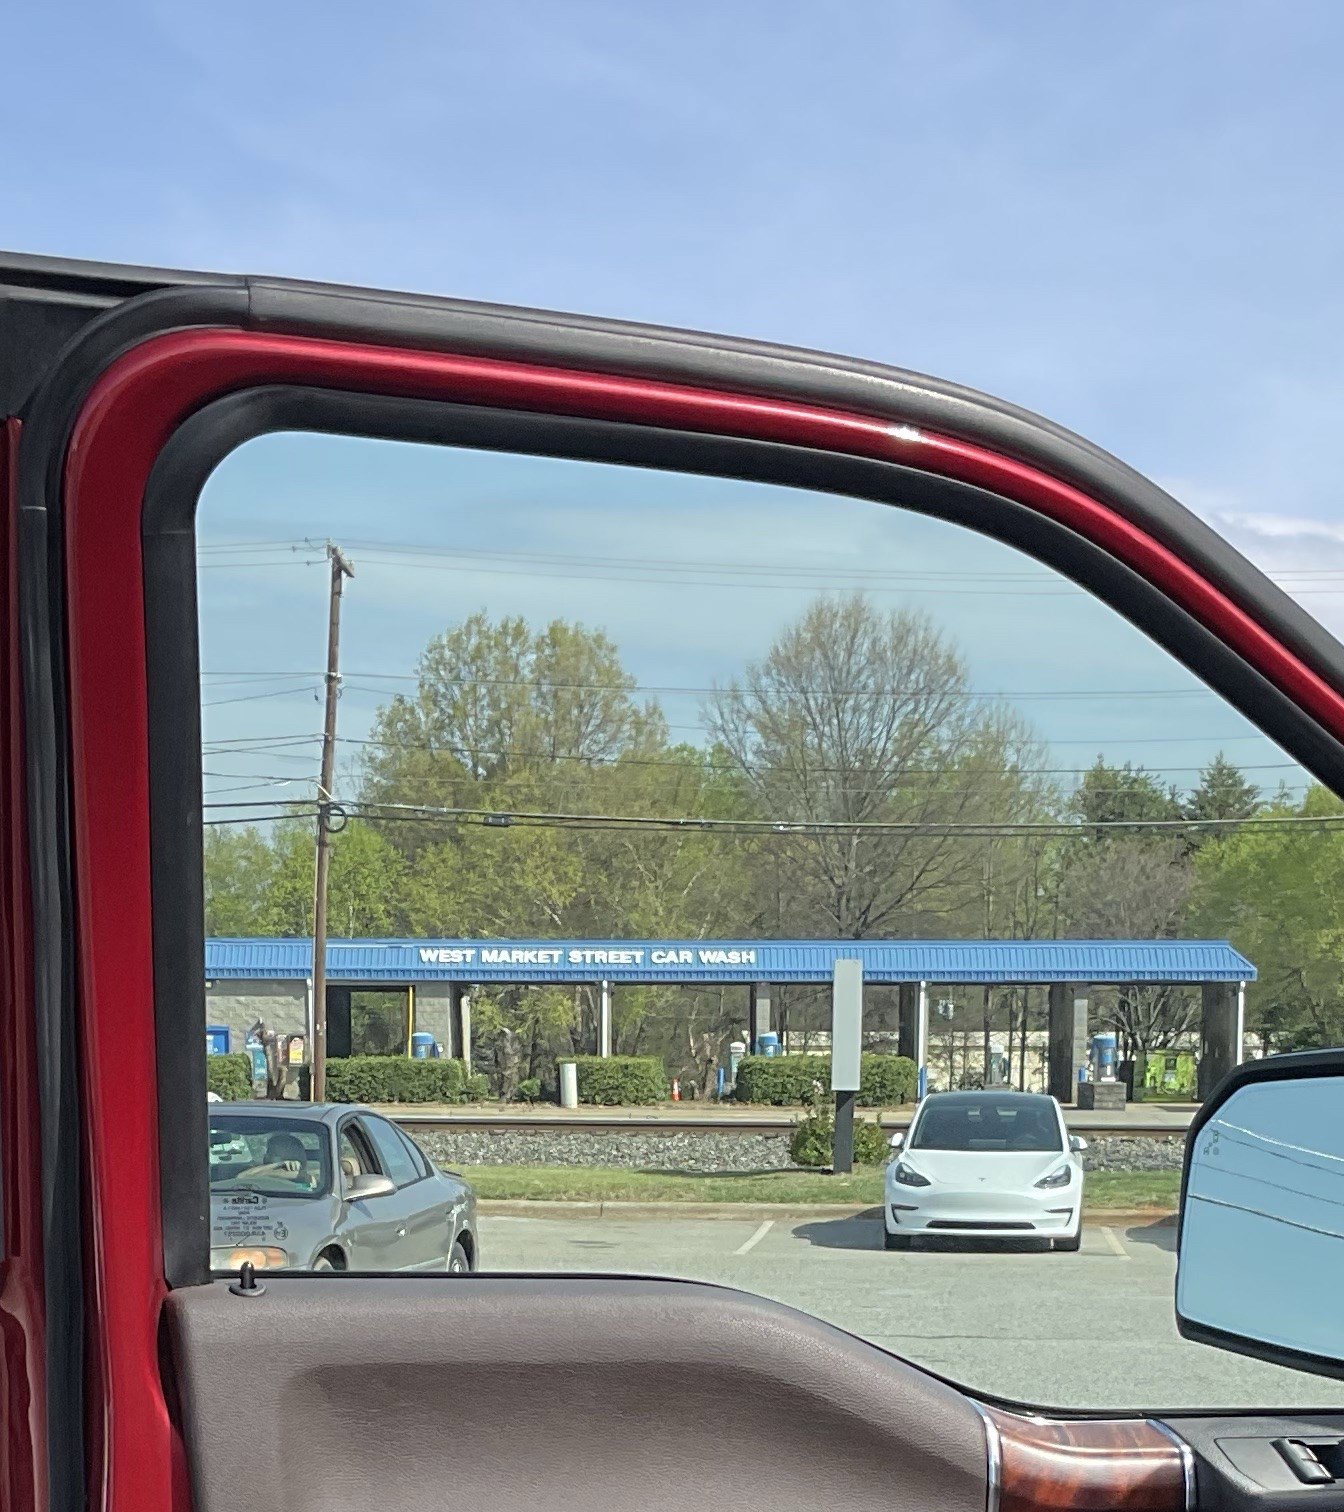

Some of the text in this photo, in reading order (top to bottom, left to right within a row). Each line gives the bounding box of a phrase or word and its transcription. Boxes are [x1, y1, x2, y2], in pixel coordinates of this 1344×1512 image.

[419, 948, 756, 964] WEST MARKET STREET CAR WASH
